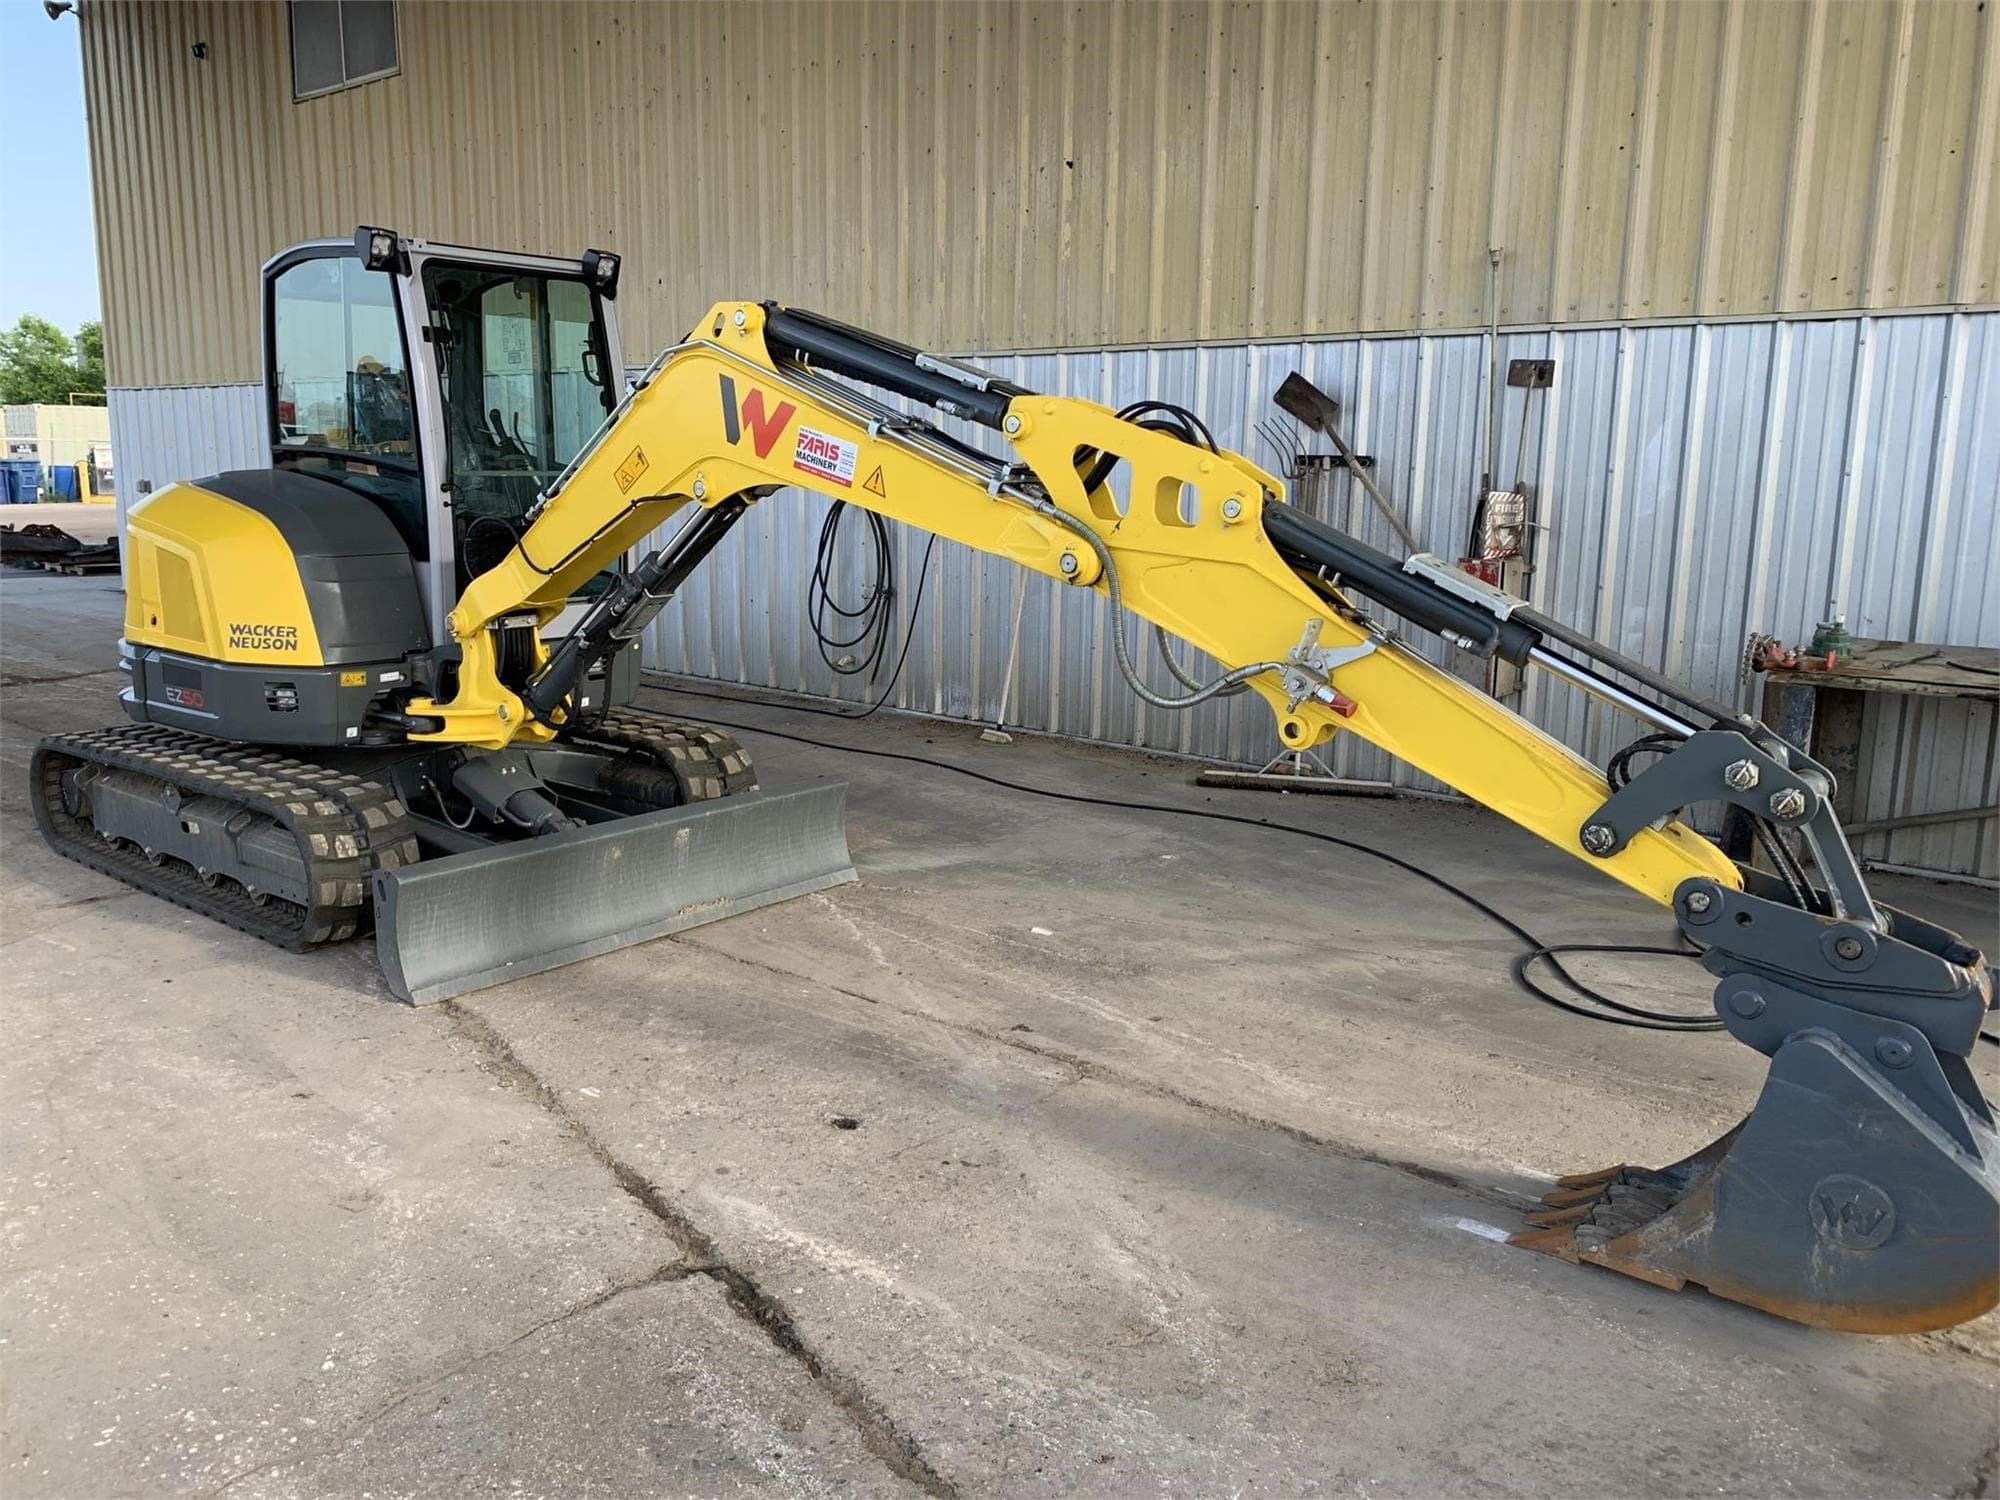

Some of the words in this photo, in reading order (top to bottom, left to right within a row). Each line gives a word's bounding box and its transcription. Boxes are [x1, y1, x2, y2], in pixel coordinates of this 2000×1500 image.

[797, 433, 840, 462] FARIS
[796, 450, 837, 472] MACHINERY
[1495, 503, 1519, 513] FIRE
[230, 623, 297, 638] WACKER
[229, 636, 297, 651] NEUSON
[165, 687, 205, 709] EZ50
